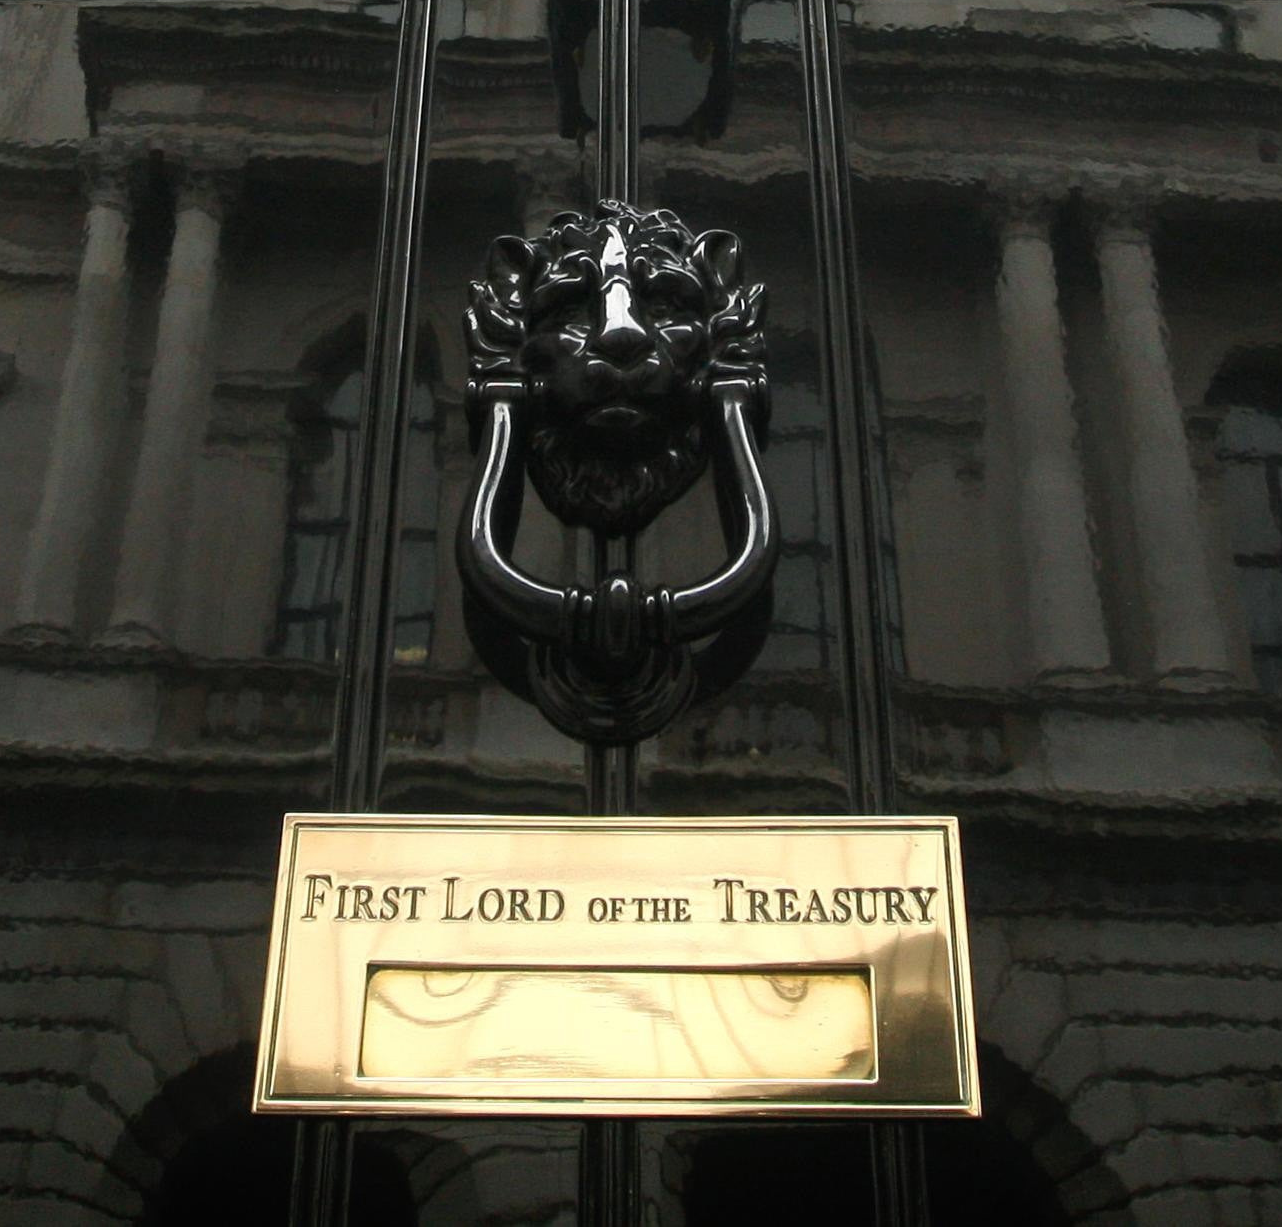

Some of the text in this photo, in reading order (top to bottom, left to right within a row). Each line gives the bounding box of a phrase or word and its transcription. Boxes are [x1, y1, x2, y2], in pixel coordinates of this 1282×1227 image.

[300, 873, 939, 923] FIRST LORD OF THE TREASURY
